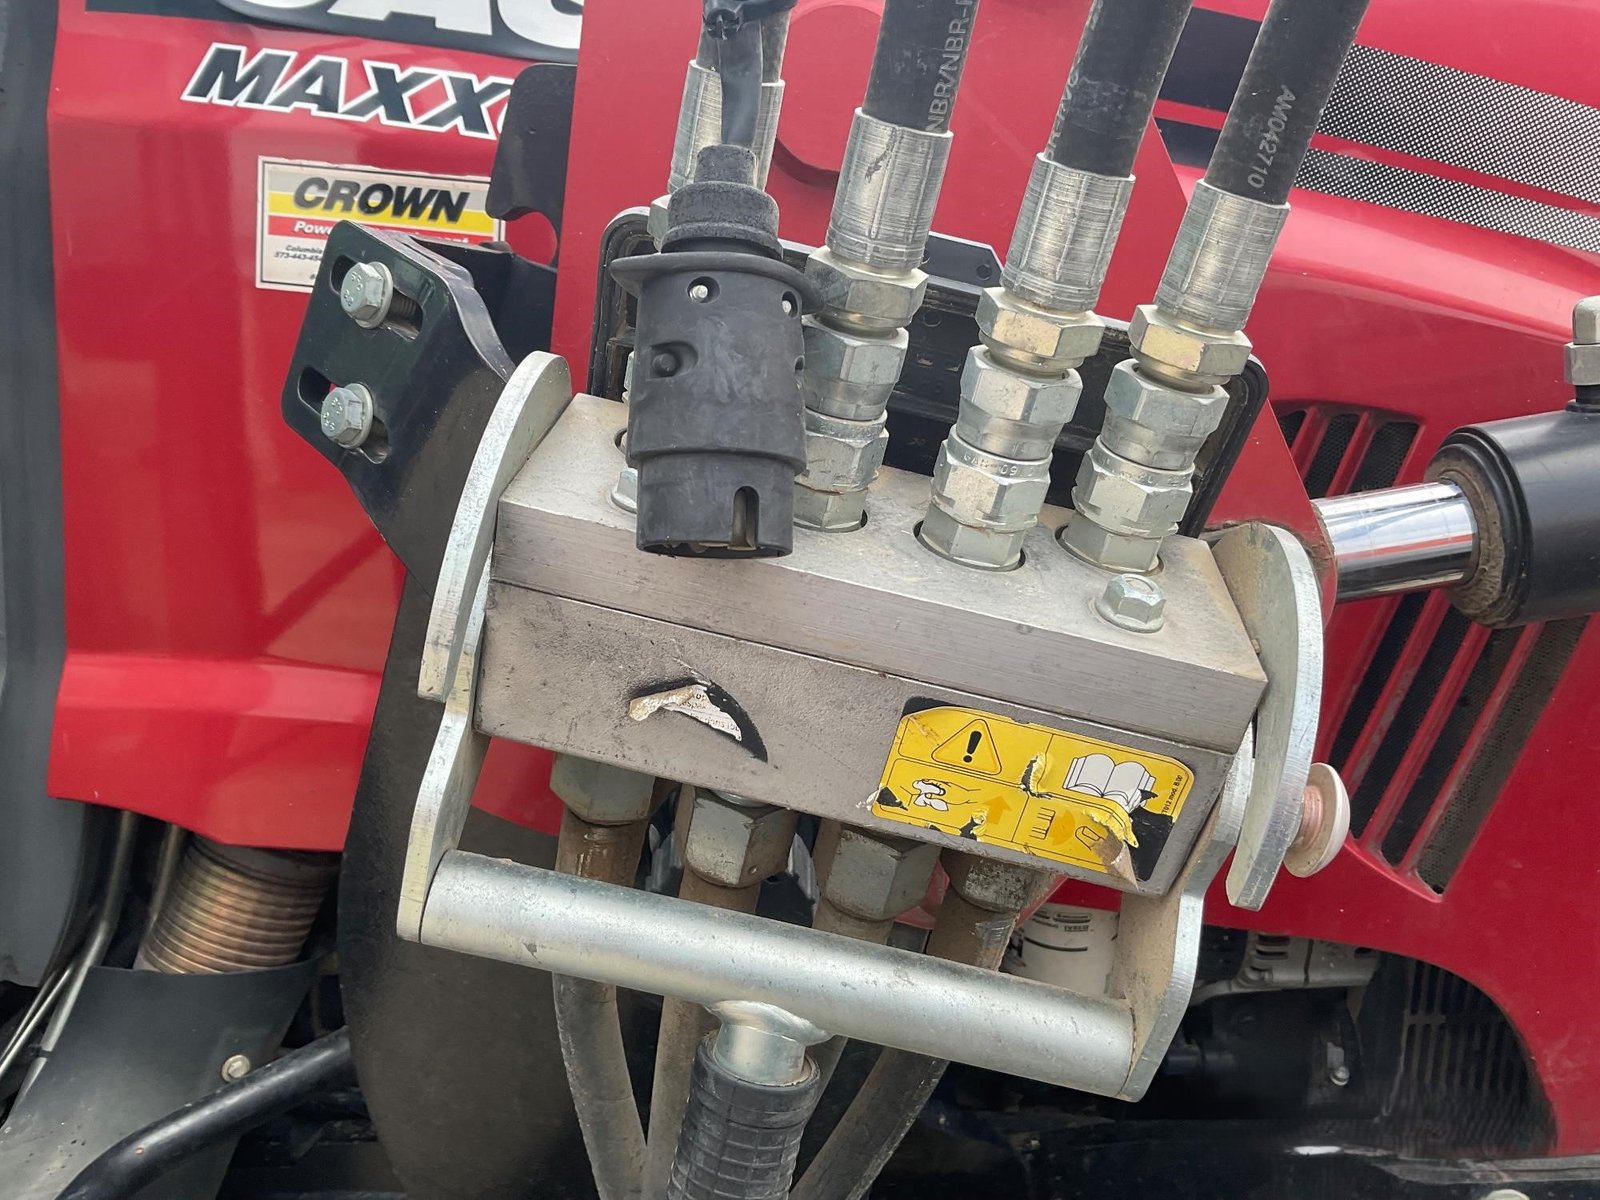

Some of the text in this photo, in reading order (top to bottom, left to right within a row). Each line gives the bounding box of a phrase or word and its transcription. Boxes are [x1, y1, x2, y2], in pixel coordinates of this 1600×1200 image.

[180, 42, 514, 140] MAXX
[925, 0, 974, 132] NBR/NBR-
[1248, 84, 1296, 188] AM042710
[293, 177, 470, 223] CROWN
